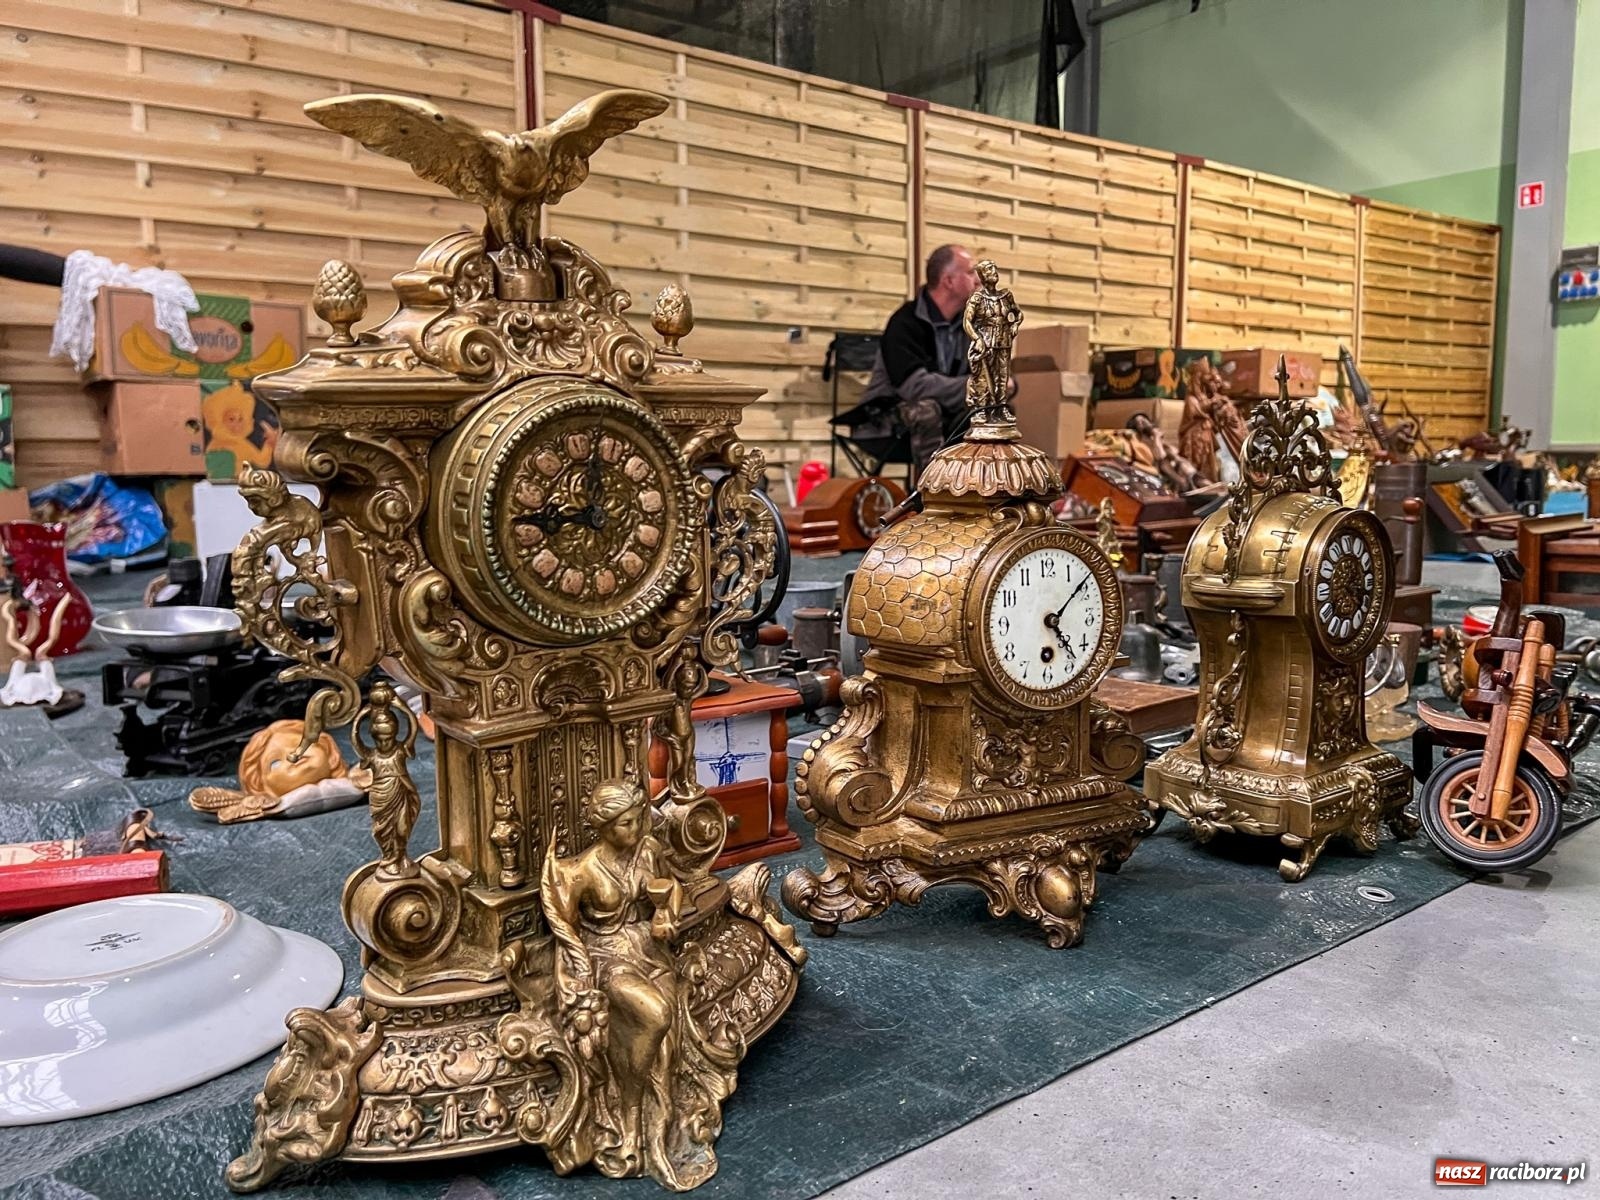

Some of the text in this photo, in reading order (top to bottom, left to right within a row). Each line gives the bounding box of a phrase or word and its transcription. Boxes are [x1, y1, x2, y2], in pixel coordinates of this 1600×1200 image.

[1020, 567, 1030, 586] 11
[1040, 557, 1056, 578] 12
[1066, 564, 1071, 582] 1
[1002, 589, 1016, 608] 10
[1079, 582, 1089, 601] 2
[998, 616, 1010, 636] 9
[1085, 607, 1095, 627] 3
[1004, 642, 1015, 661] 8
[1079, 633, 1089, 652] 4
[1020, 661, 1030, 679] 7
[1064, 653, 1077, 674] 5
[1042, 665, 1053, 684] 6
